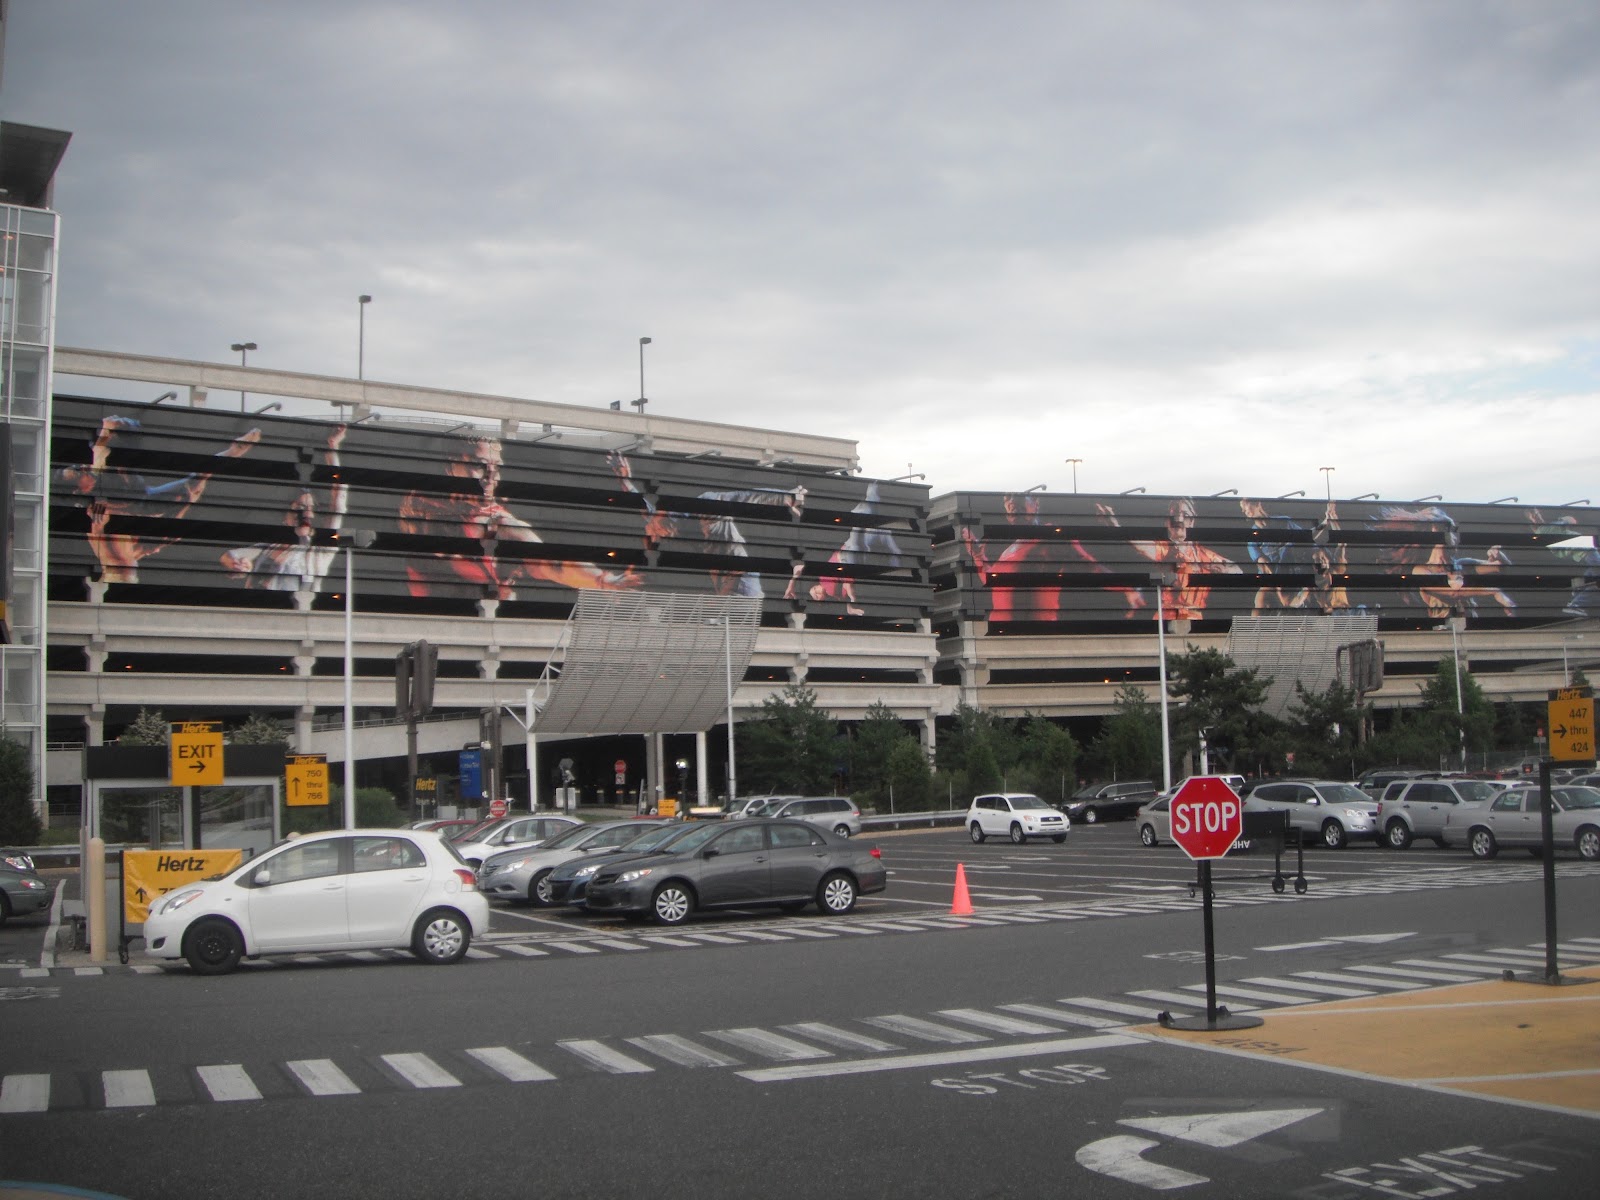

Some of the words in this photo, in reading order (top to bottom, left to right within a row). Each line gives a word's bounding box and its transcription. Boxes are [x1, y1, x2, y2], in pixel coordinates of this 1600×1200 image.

[1569, 708, 1587, 719] 447
[1570, 726, 1588, 735] thru
[178, 744, 215, 759] EXIT
[1571, 742, 1589, 752] 424
[415, 778, 436, 790] Hertz
[1175, 802, 1237, 834] STOP
[157, 856, 205, 872] Hertz
[930, 1064, 1111, 1095] STOP
[1321, 1145, 1557, 1200] EXIT
